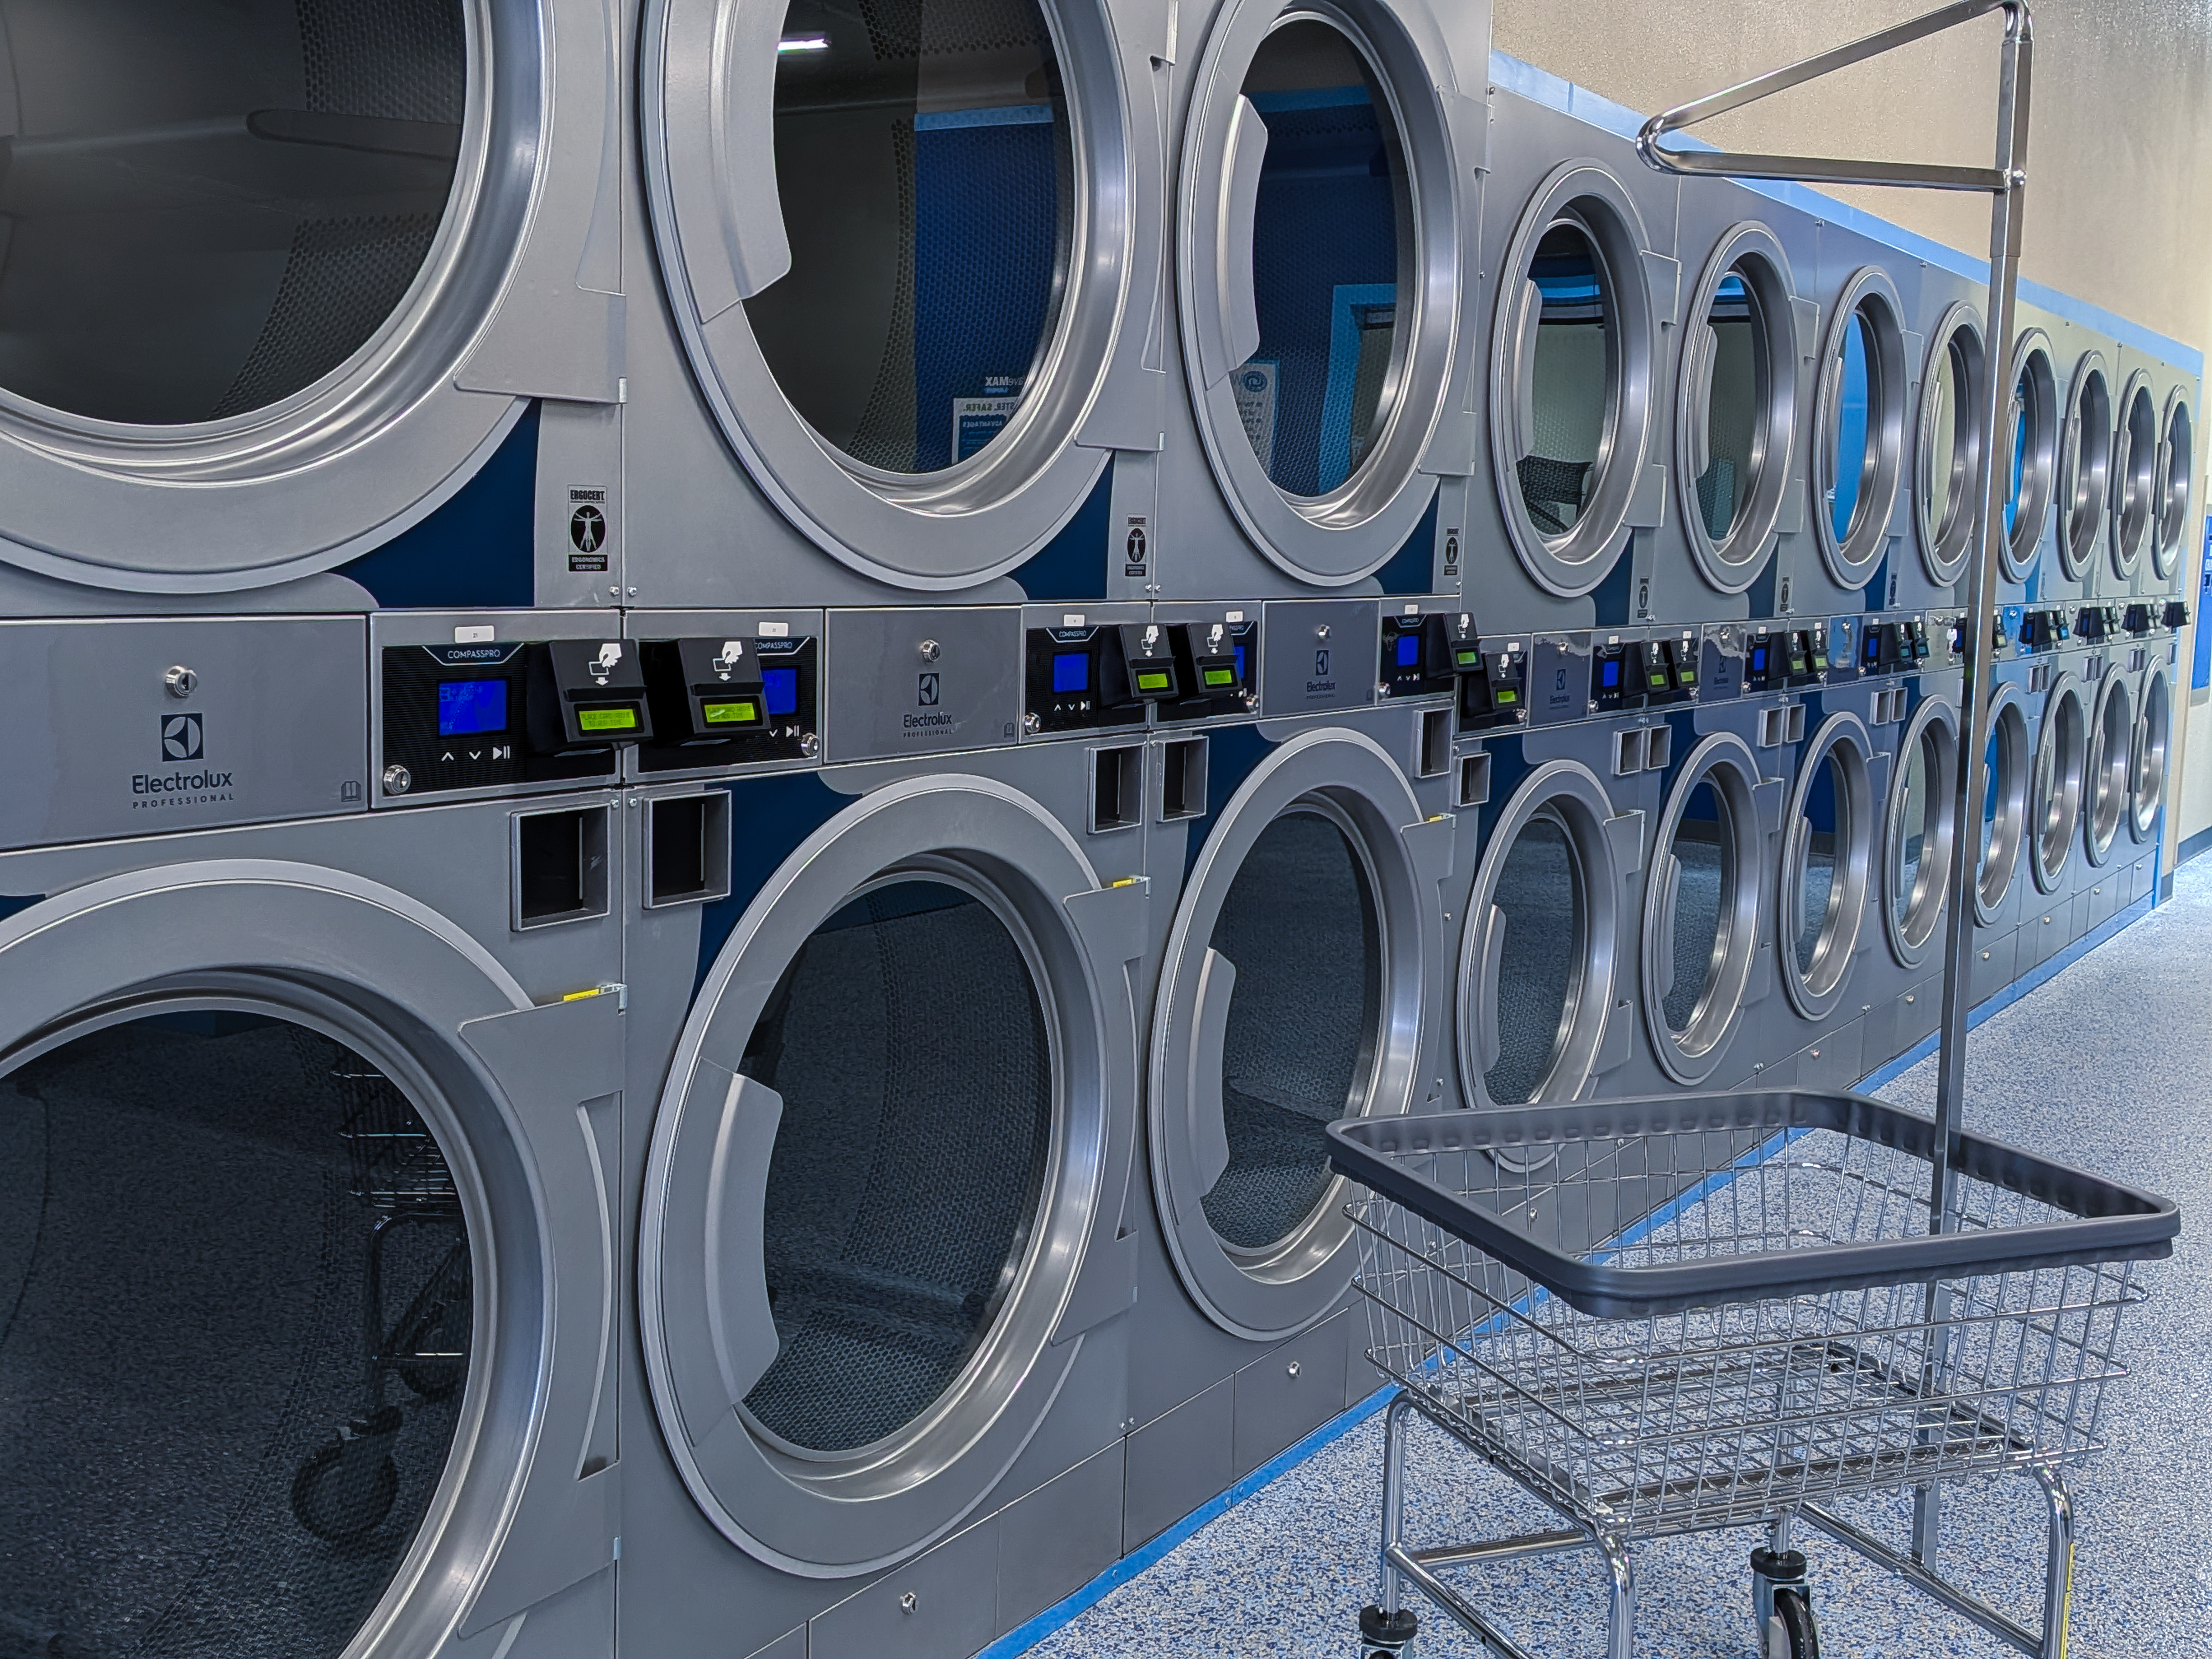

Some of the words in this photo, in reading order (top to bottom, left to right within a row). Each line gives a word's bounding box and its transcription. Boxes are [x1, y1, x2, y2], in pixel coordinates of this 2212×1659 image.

[570, 490, 605, 500] ERGOCERT
[447, 649, 500, 659] COMPASSPRO
[904, 712, 952, 728] Electrolux
[132, 769, 233, 794] Electrolux
[133, 793, 234, 809] PROFESSIONAL
